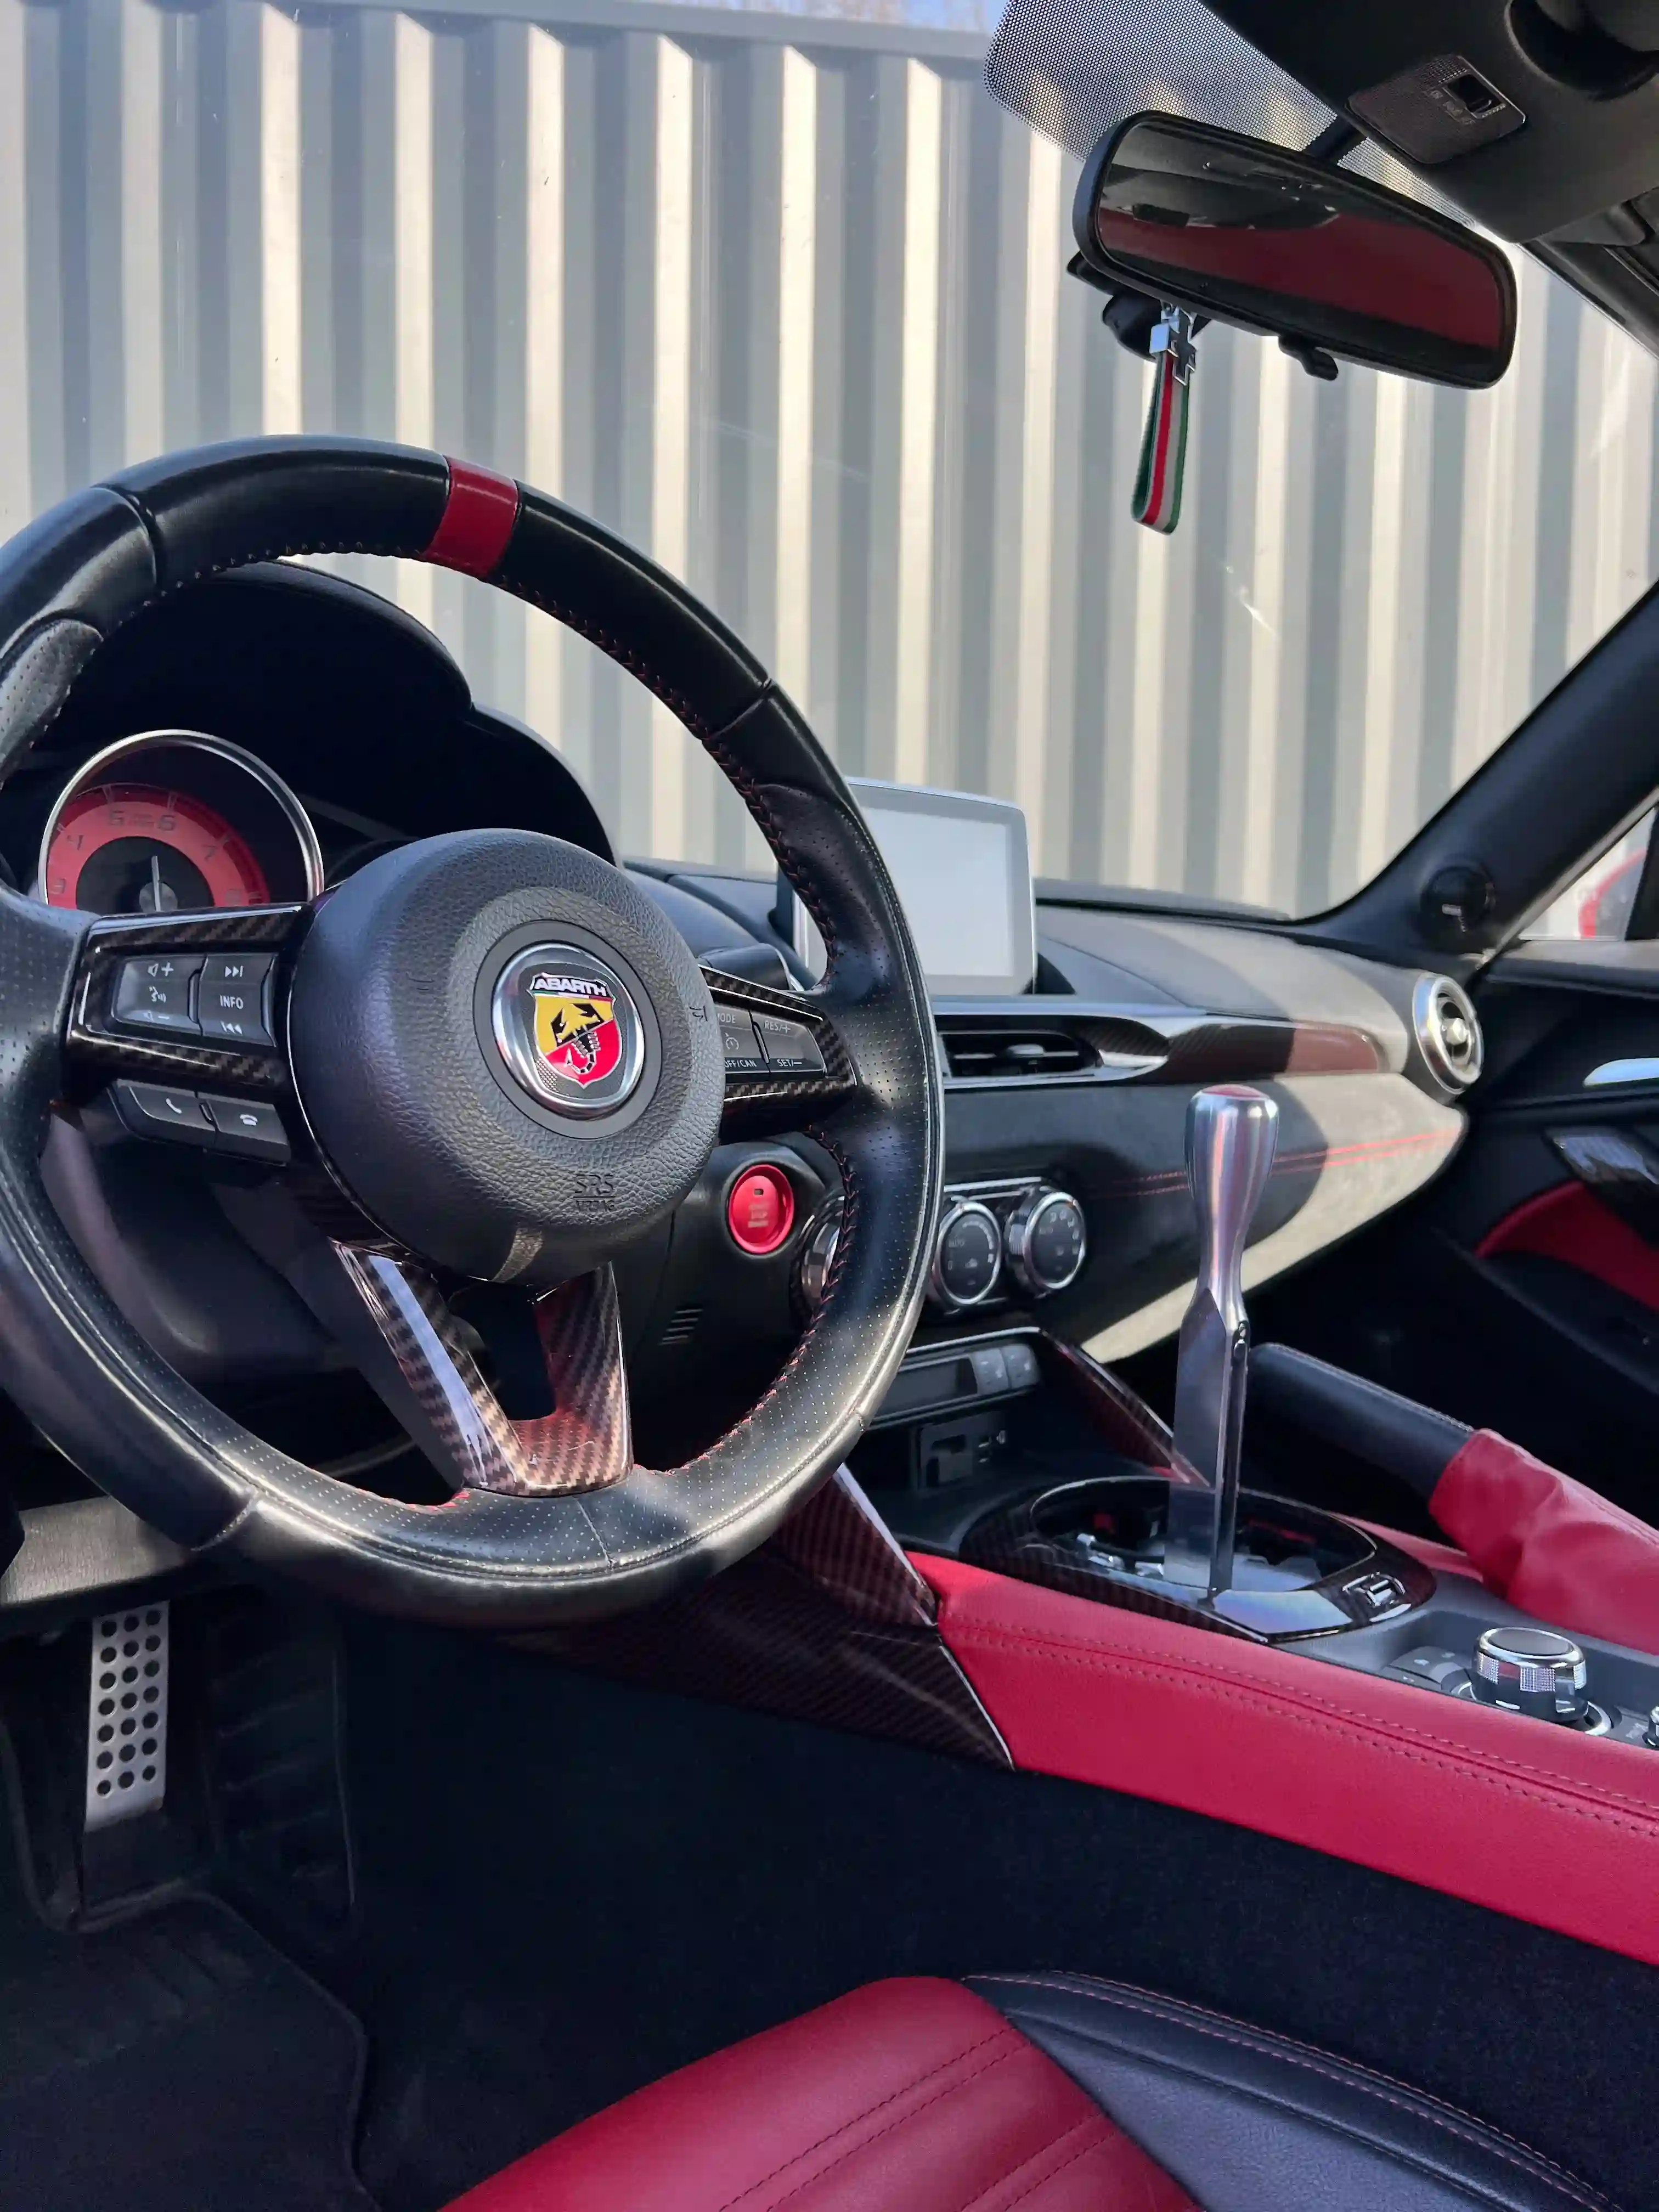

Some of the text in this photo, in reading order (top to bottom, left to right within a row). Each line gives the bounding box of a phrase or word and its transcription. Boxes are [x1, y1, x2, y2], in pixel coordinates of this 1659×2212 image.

[534, 978, 607, 997] ABARTH
[219, 994, 244, 1009] INFO
[574, 1173, 614, 1194] SRS
